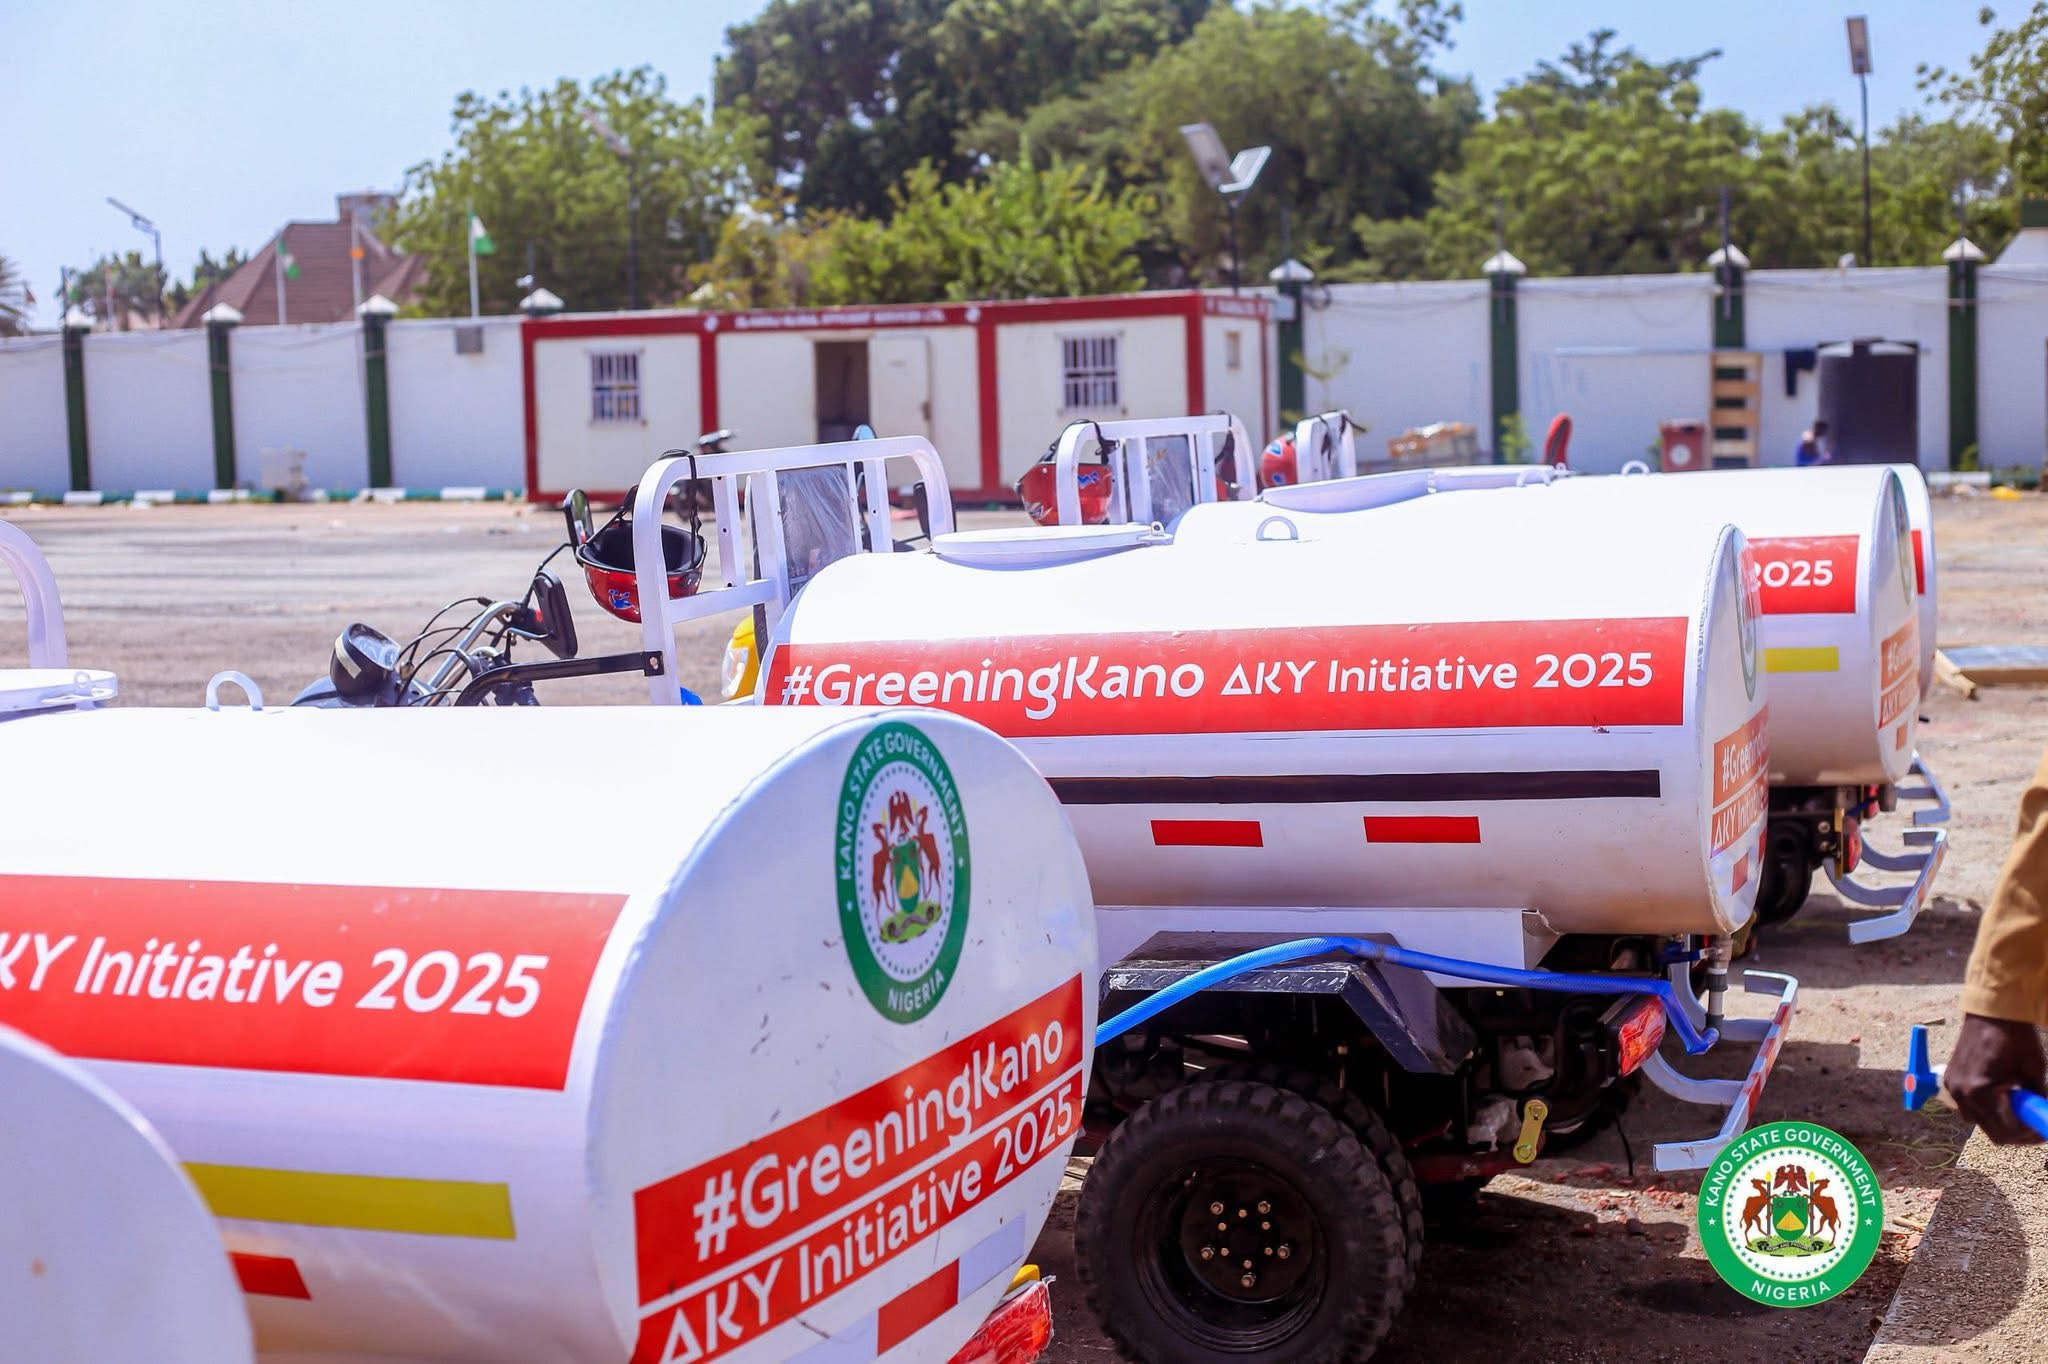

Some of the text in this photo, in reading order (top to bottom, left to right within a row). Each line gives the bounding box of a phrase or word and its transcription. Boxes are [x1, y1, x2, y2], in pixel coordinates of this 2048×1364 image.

[781, 651, 1654, 721] #GreeningKano AKY Initiative 2025
[840, 732, 964, 880] KANO STATE GOVERNMENT
[0, 932, 550, 1018] KY Initiative 2025
[887, 968, 945, 1013] NIGERIA
[692, 1020, 1064, 1262] #GreeningKano
[659, 1084, 1073, 1364] AKY Initiative 2025
